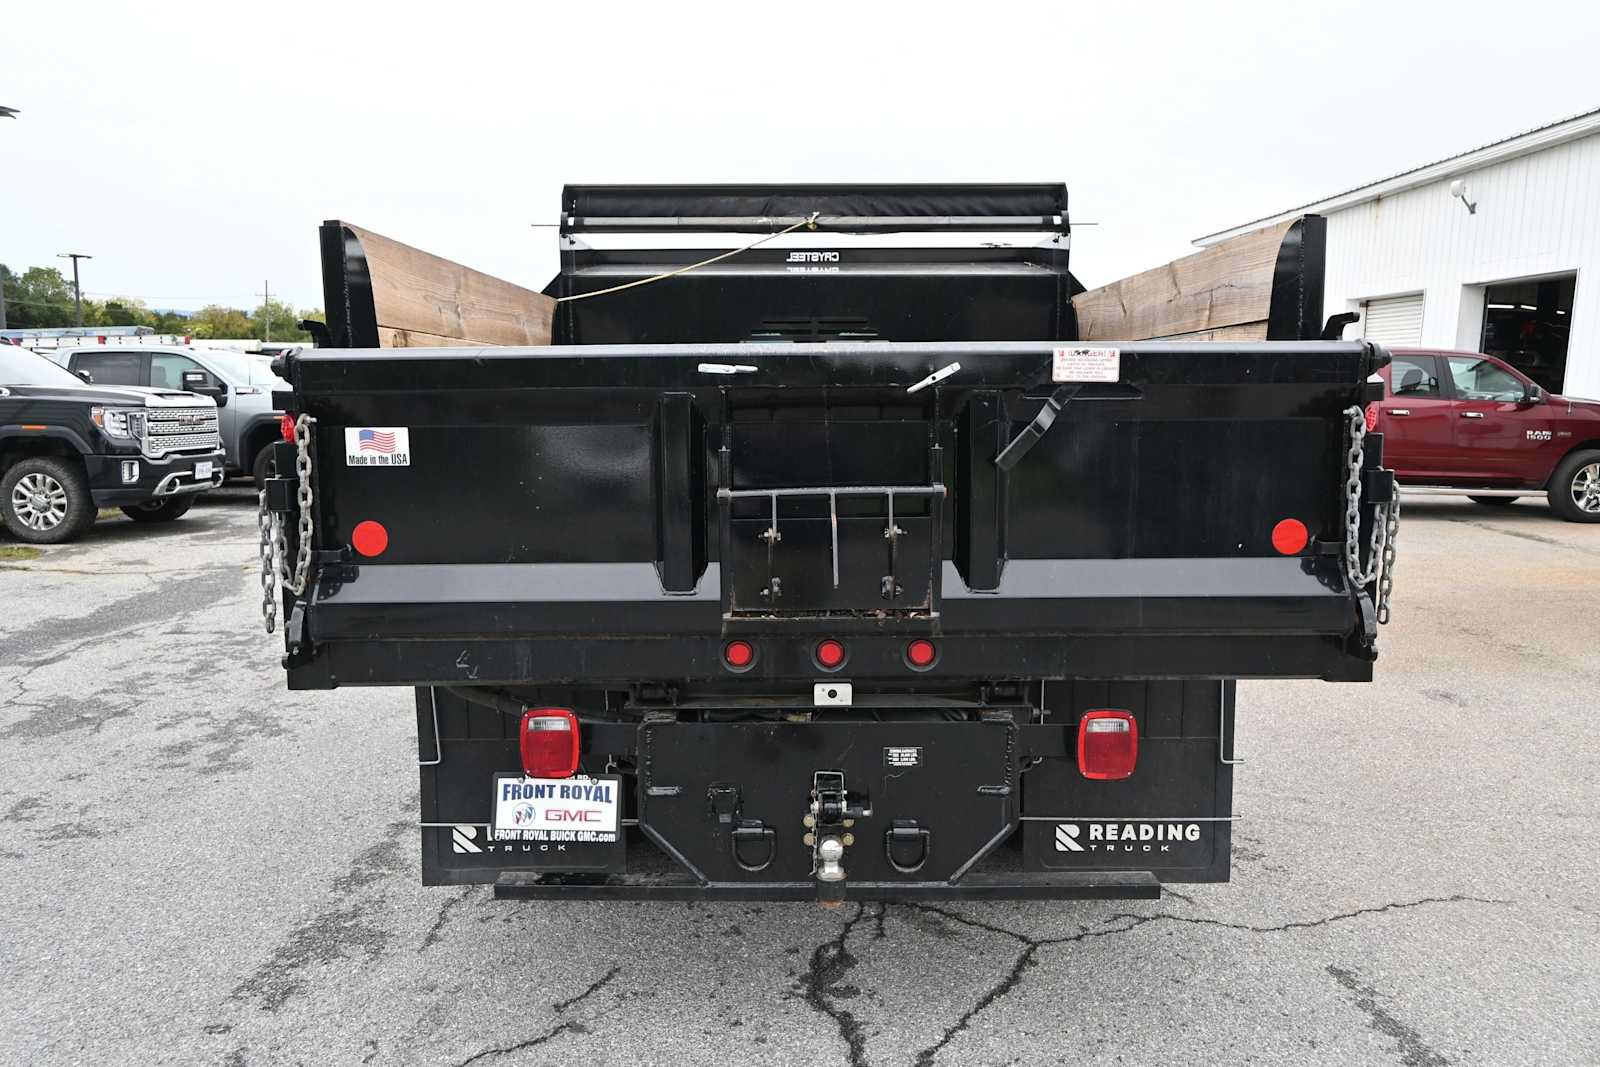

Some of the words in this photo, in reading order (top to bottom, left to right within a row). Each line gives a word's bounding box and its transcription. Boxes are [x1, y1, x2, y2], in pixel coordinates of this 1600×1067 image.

[348, 455, 368, 465] Made
[370, 455, 377, 465] in
[378, 455, 389, 465] the
[391, 454, 408, 465] USA
[503, 783, 556, 801] FRONT
[560, 784, 612, 803] ROYAL
[545, 809, 602, 822] GMC
[494, 829, 522, 841] FRONT
[522, 830, 549, 841] ROYAL
[550, 830, 576, 842] BUICK
[577, 831, 616, 843] GMC.com
[1089, 823, 1201, 841] READING
[488, 844, 566, 852] TRUCK
[1089, 844, 1169, 852] TRUCK
